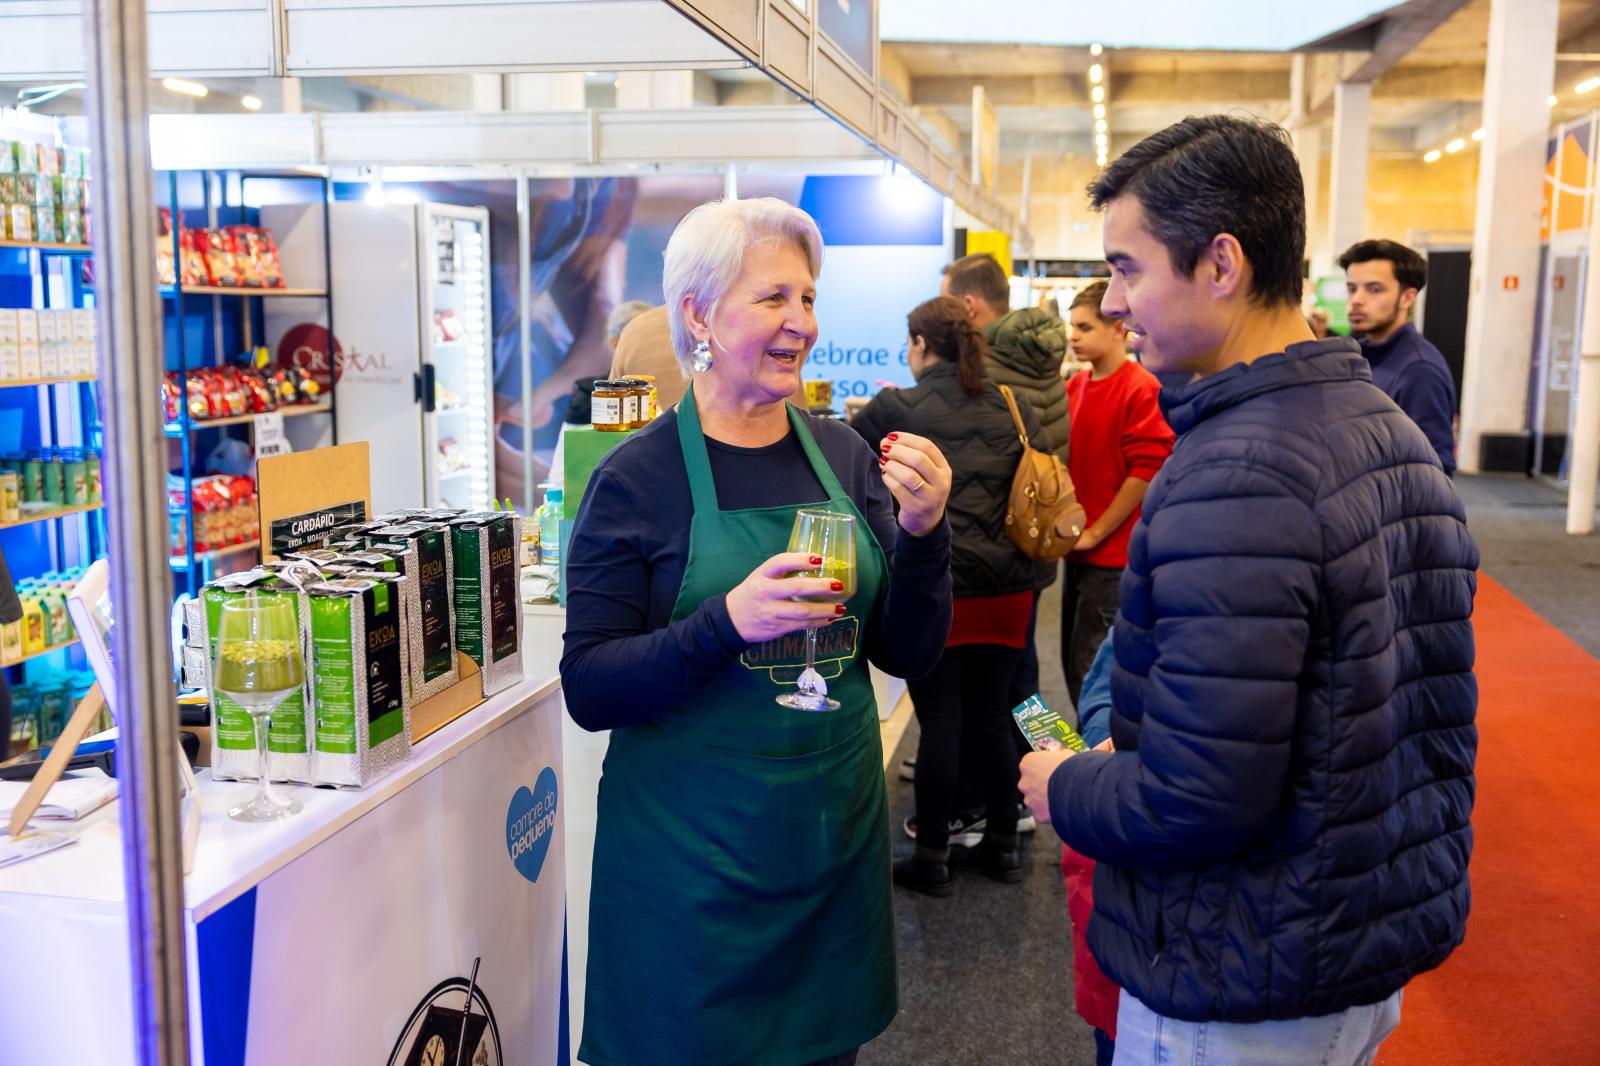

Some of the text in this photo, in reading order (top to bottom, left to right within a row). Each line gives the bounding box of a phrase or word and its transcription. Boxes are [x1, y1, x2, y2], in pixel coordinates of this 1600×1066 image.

[292, 345, 391, 372] CRSTAL
[291, 513, 334, 535] CARDÁPIO
[491, 547, 512, 565] EKOA
[421, 560, 443, 578] EKOA
[368, 624, 396, 648] EKOA
[510, 790, 554, 840] compre do
[511, 810, 555, 860] pequeno
